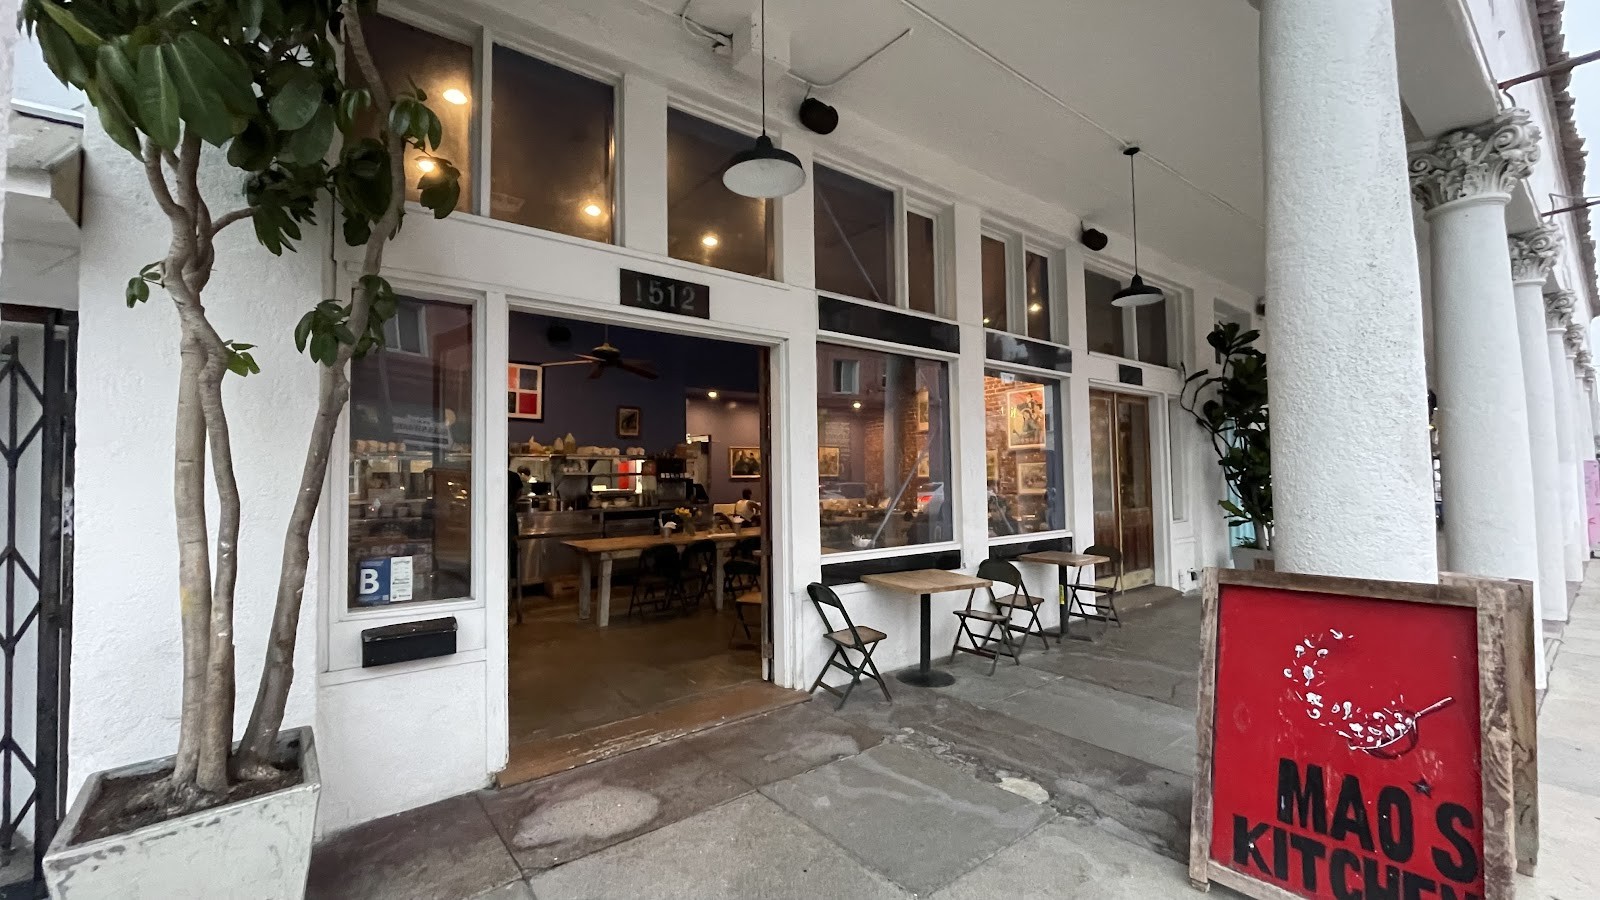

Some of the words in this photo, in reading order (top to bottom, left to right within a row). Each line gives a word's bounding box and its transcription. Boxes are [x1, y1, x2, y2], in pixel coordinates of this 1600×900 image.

[636, 279, 695, 310] 1512
[360, 568, 379, 594] B
[1233, 814, 1482, 900] KITCH
